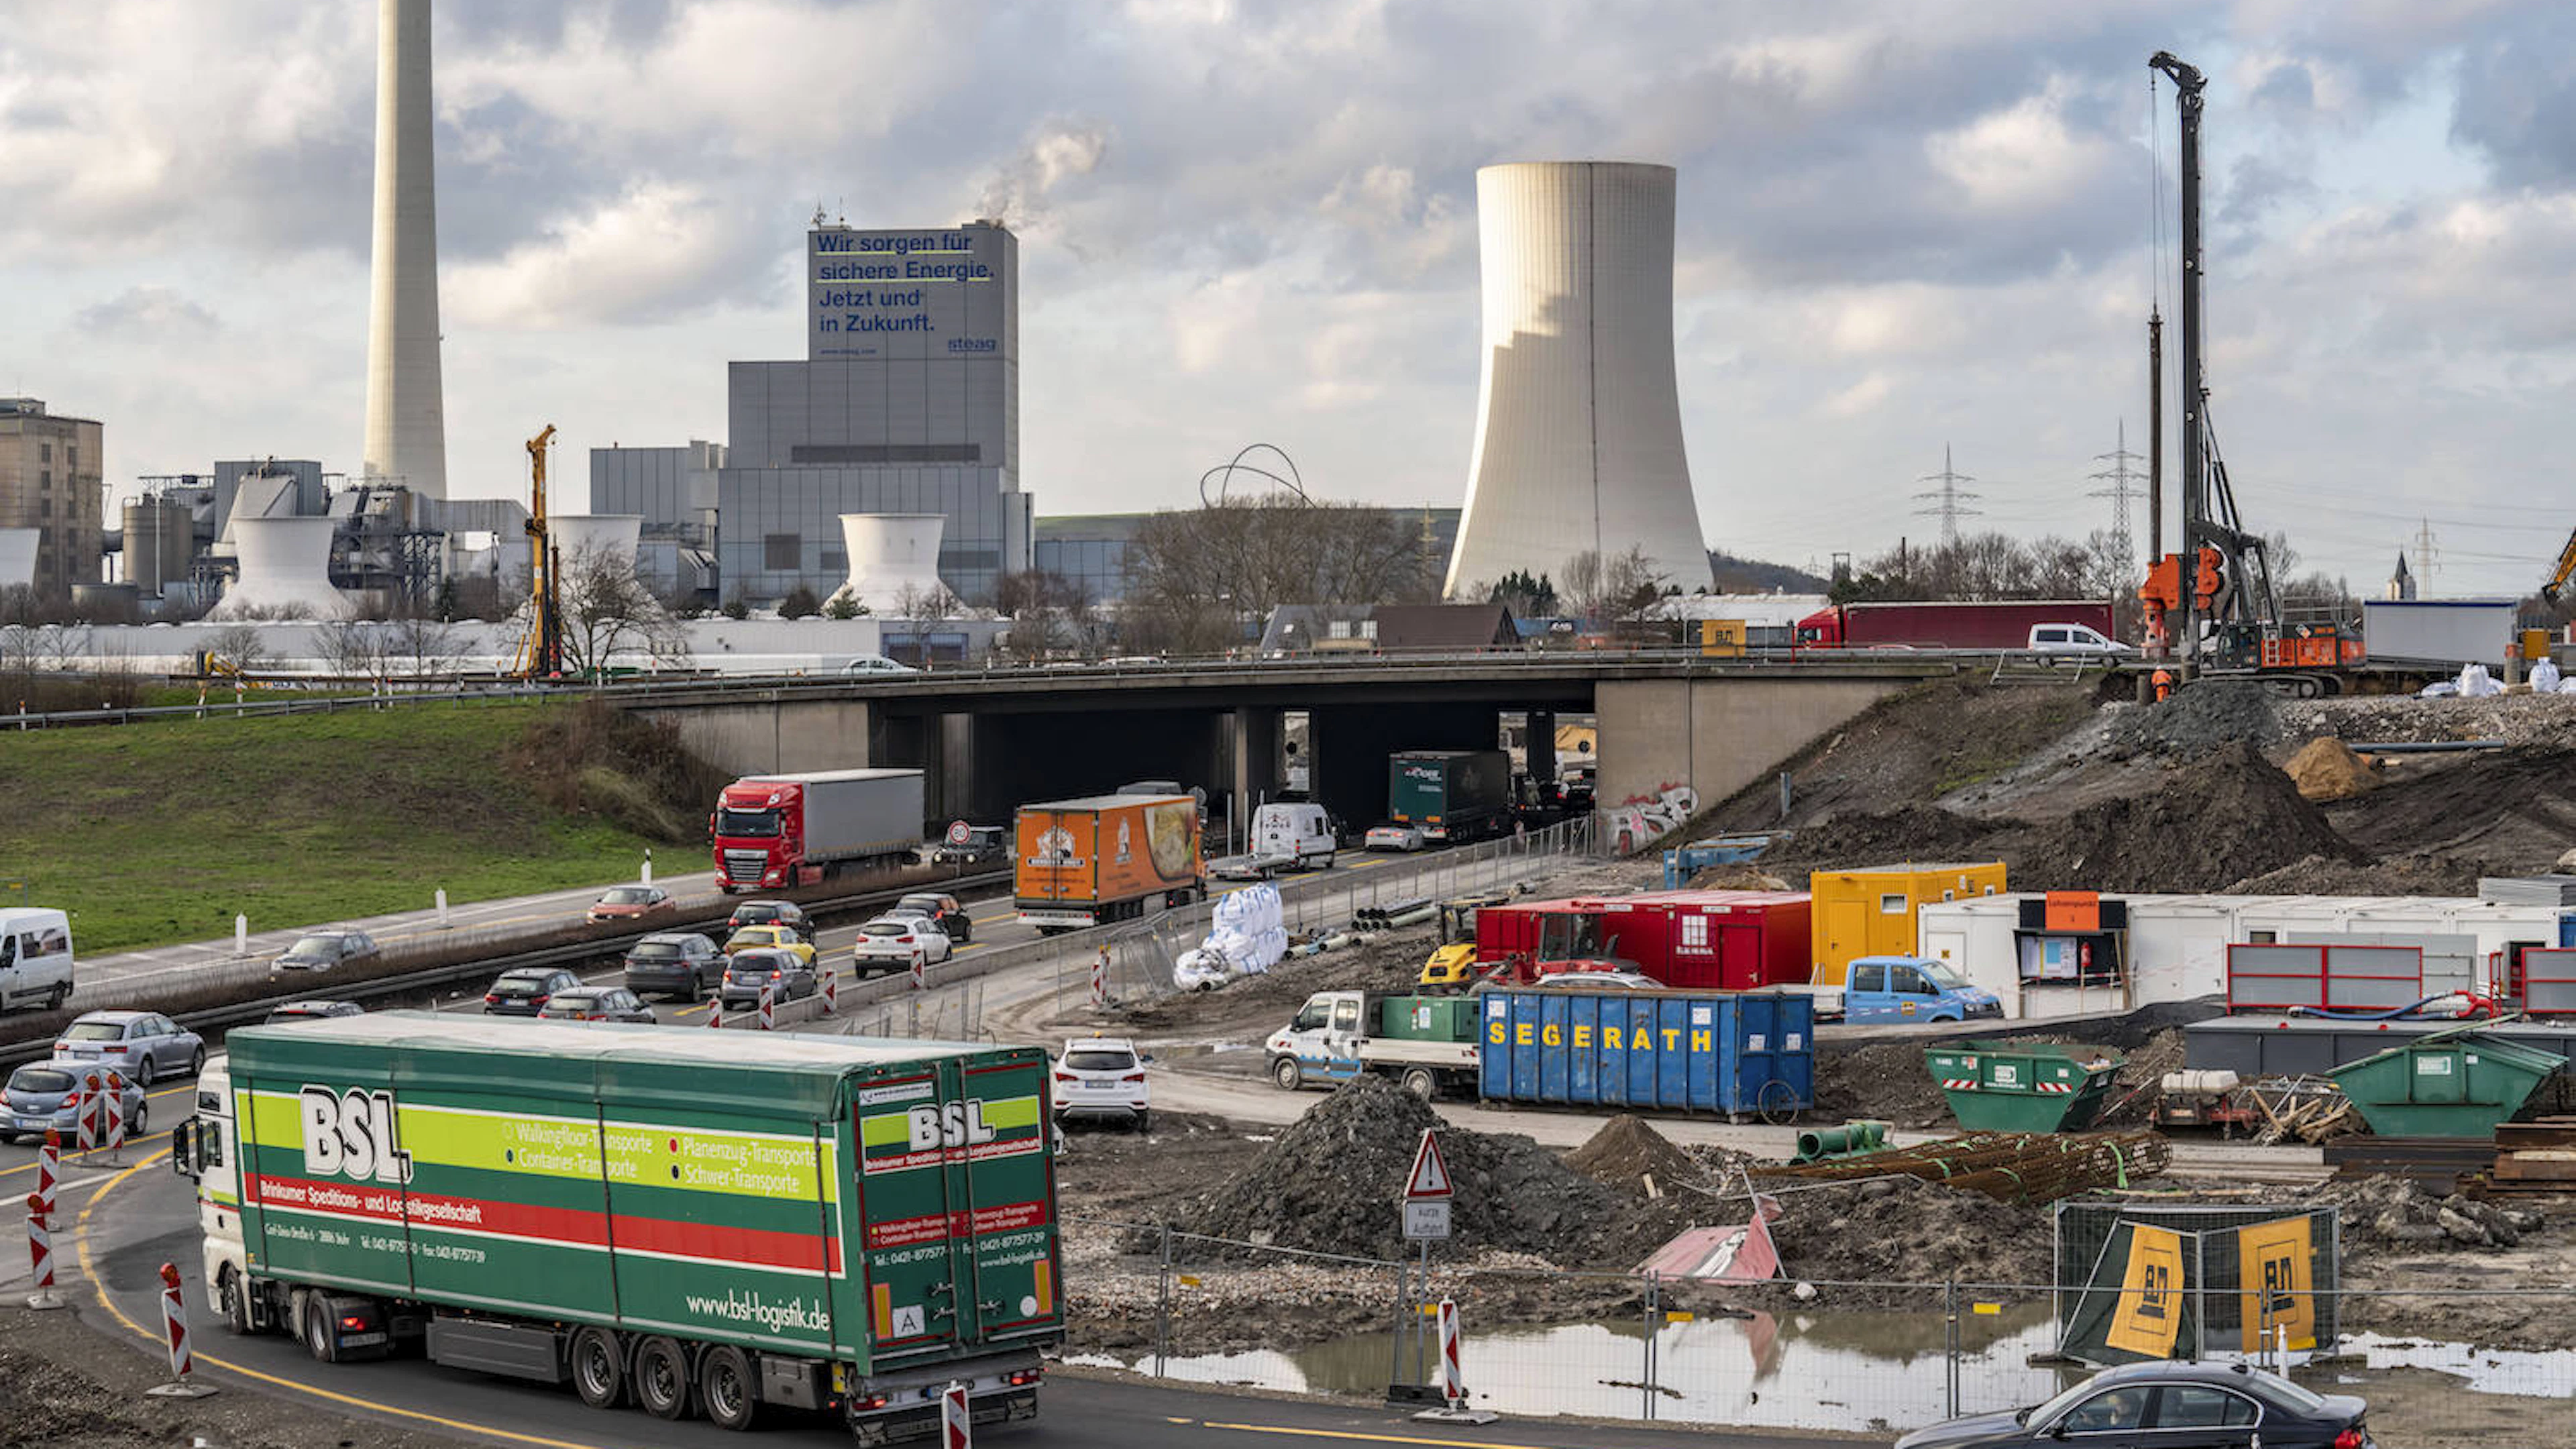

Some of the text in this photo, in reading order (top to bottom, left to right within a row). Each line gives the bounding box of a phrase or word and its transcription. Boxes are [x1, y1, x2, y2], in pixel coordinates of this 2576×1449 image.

[818, 232, 972, 254] Wir sorgen für
[820, 260, 994, 281] sichere Energie.
[819, 289, 920, 307] Jetzt und
[820, 314, 934, 331] in Zukunft.
[948, 337, 996, 352] steag
[1489, 1022, 1712, 1053] SEGERATH
[301, 1084, 414, 1184] BSL
[908, 1097, 996, 1151] BSL
[683, 1137, 818, 1170] Planenzug-Transporte
[685, 1164, 800, 1197] Schwer-Transporte
[260, 1180, 482, 1224] Brinkumer Speditions- und Logstikgesellschaft
[686, 1287, 832, 1333] www.bsl-logistik.de
[901, 1311, 917, 1332] A
